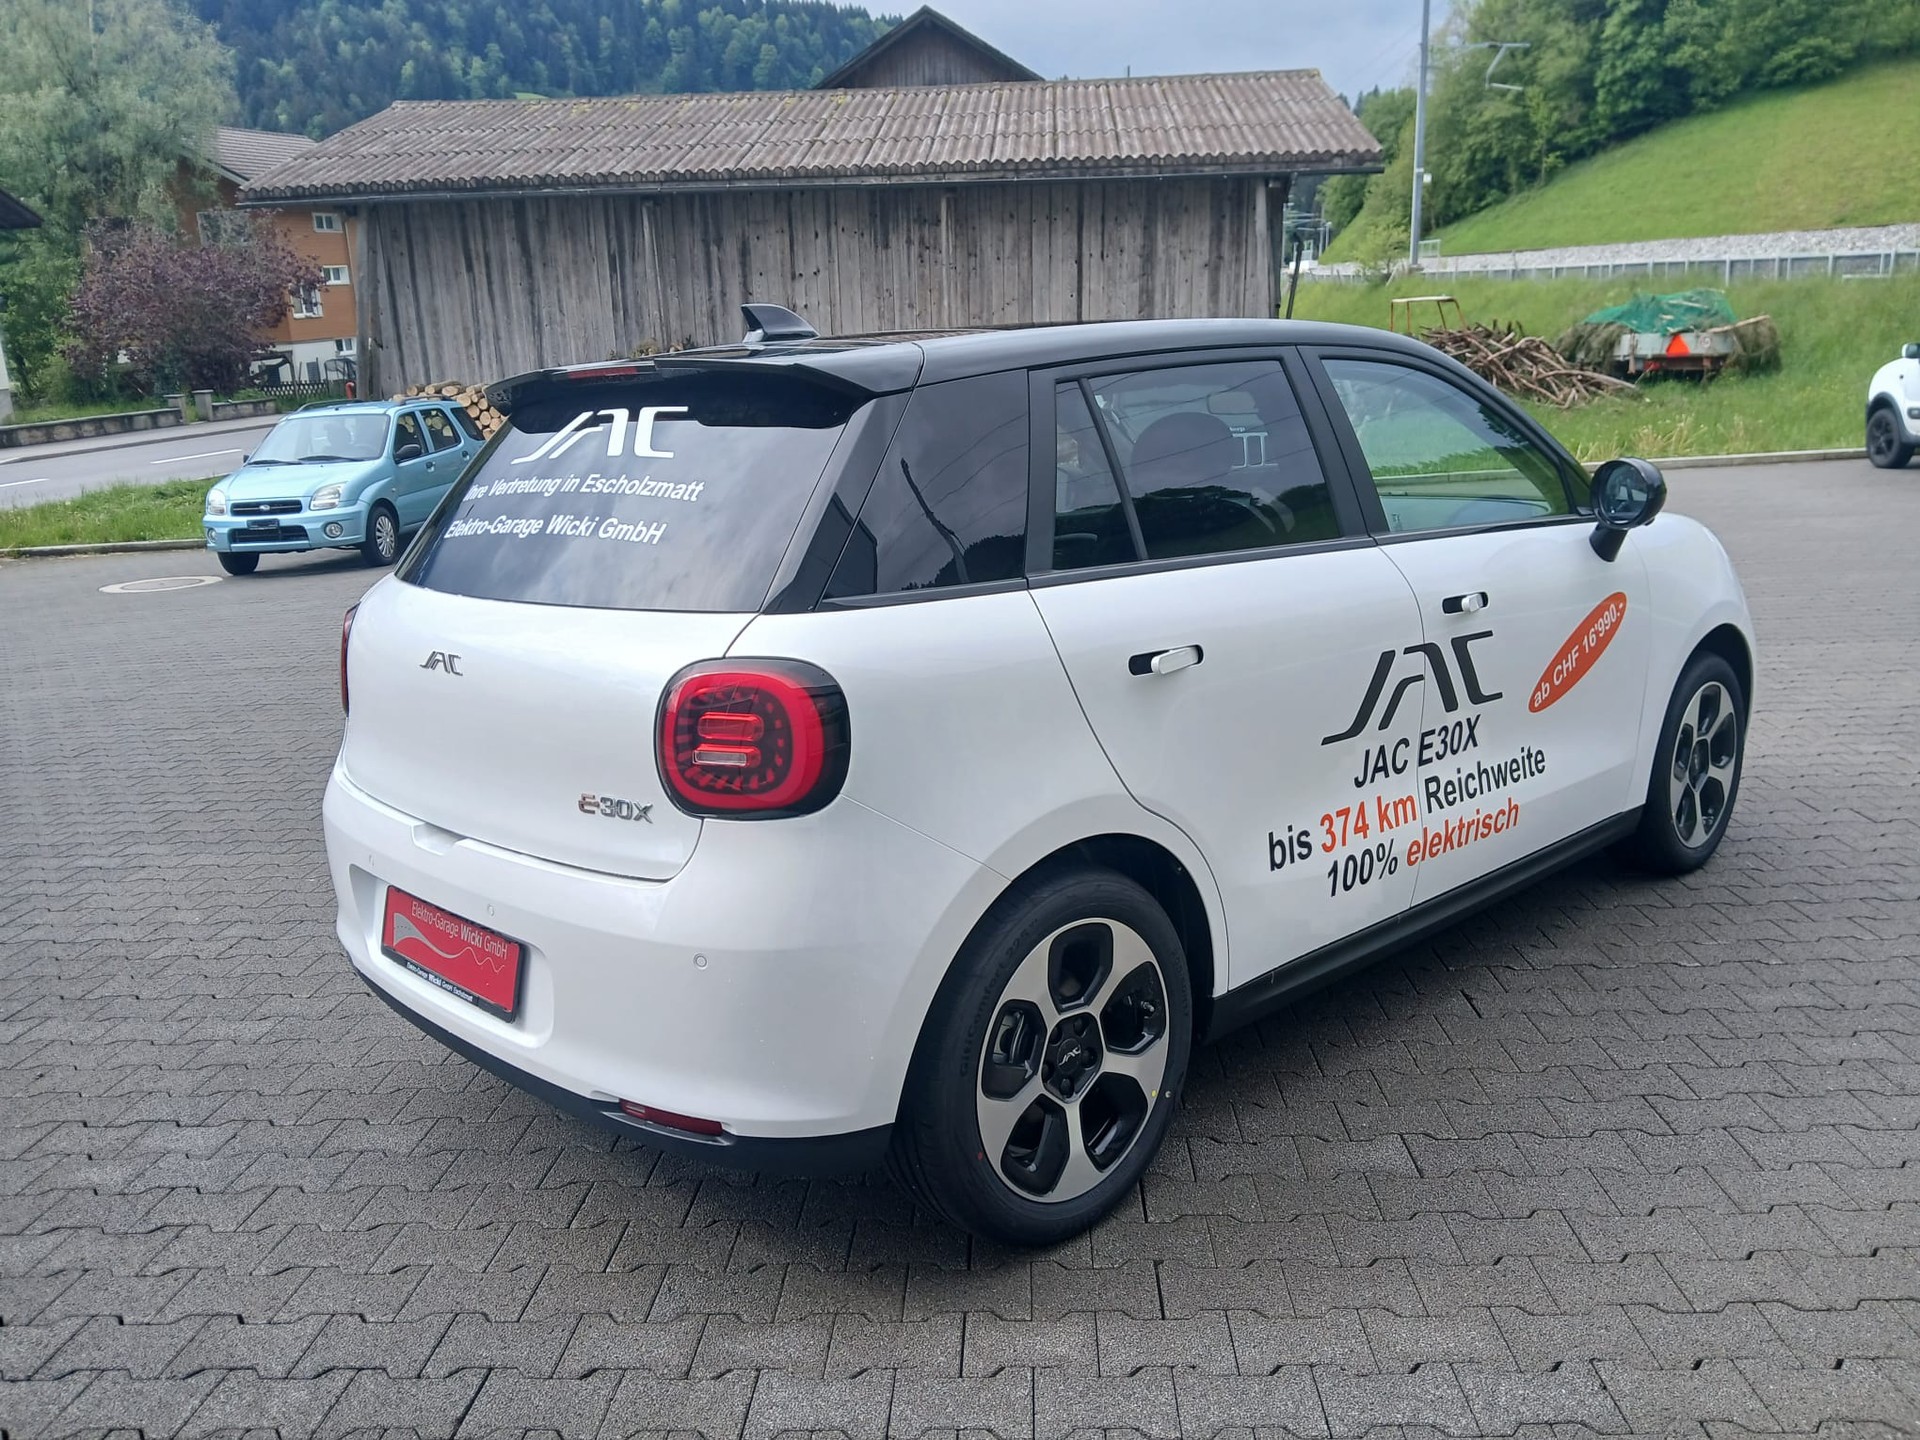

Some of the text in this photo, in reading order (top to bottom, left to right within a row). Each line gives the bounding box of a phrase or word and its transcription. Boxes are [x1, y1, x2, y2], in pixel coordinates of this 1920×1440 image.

[488, 476, 562, 498] Vertretung
[560, 474, 581, 493] in
[580, 473, 705, 502] Escholzmatt
[443, 514, 668, 545] Elektro-Garage Wicki GmbH
[1534, 602, 1623, 708] ab CHF 16'990.-
[1354, 714, 1481, 789] JAC E30X
[578, 793, 653, 824] E30X
[1268, 746, 1546, 872] bis 374 km Reichweite
[1326, 797, 1519, 897] 100% elektrisch
[411, 901, 508, 960] Elektro-Garage Wicki GmbH
